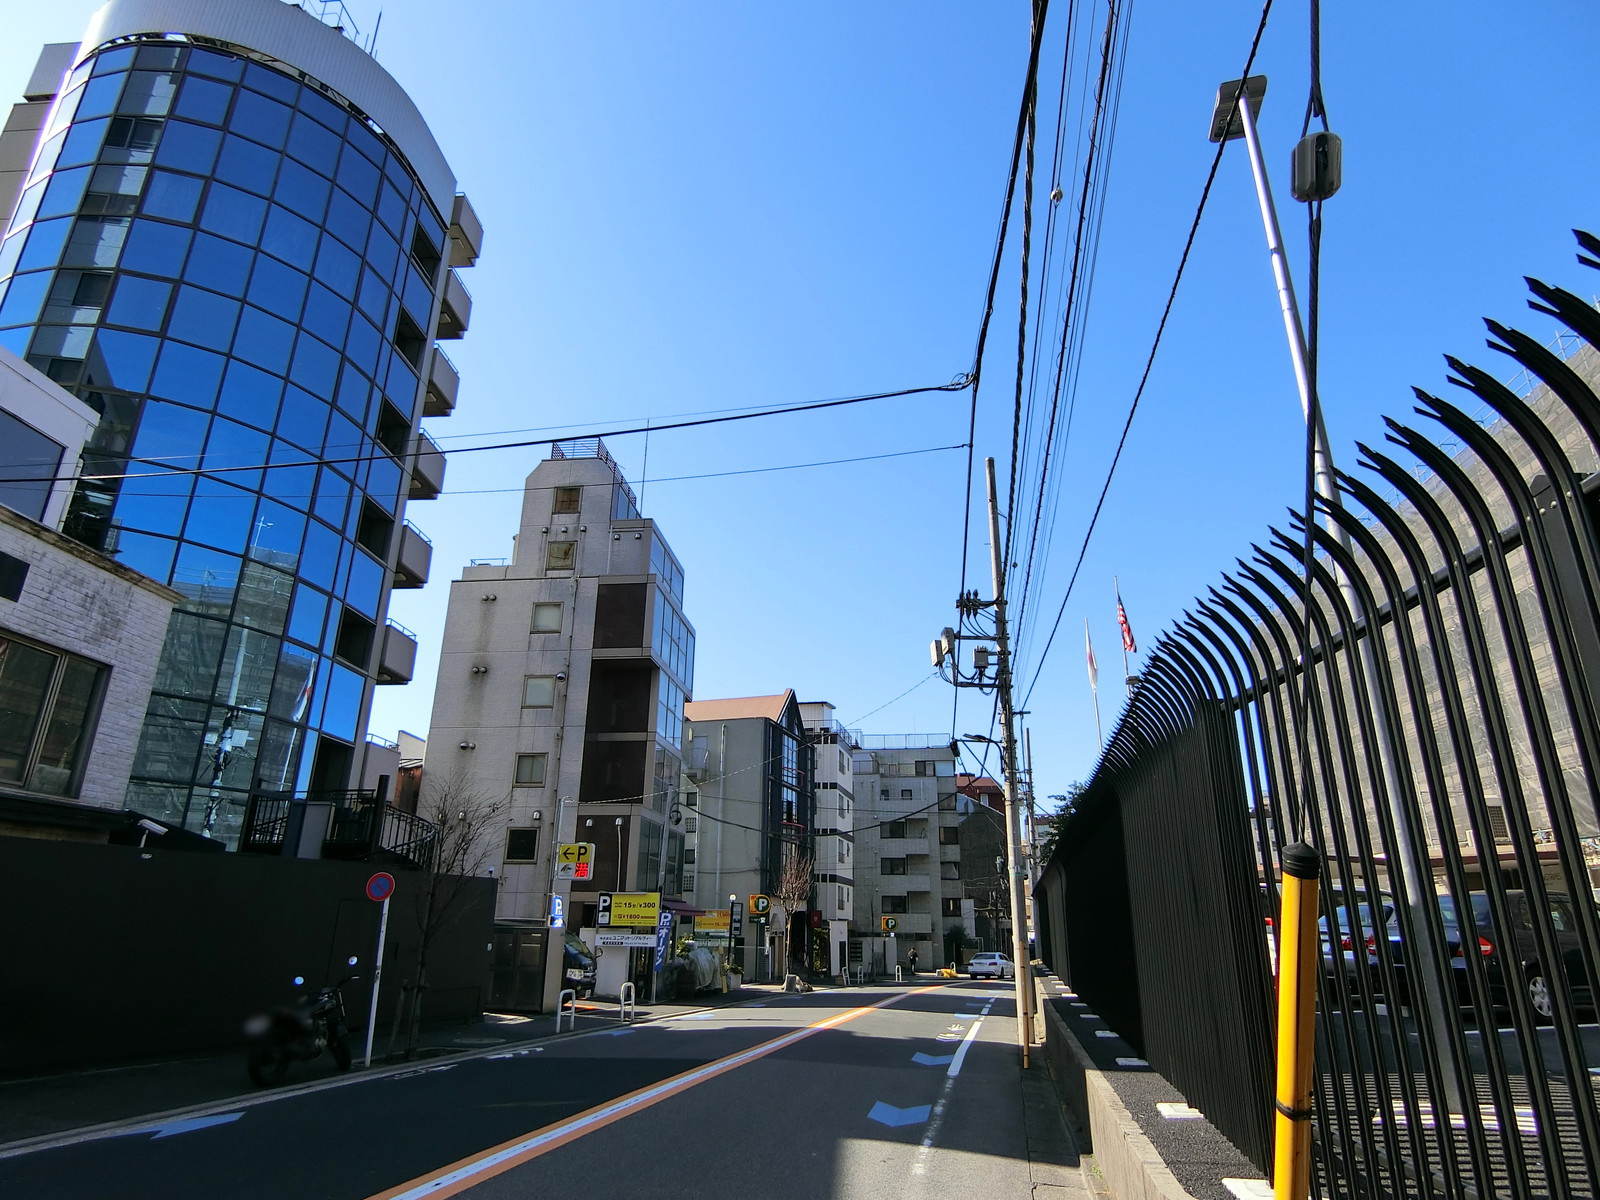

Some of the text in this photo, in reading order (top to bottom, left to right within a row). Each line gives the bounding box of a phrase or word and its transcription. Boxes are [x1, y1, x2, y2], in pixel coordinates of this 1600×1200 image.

[577, 846, 588, 861] P
[574, 863, 588, 878] 満
[599, 896, 610, 911] P
[758, 899, 768, 911] P
[660, 913, 672, 926] P
[888, 919, 895, 928] P
